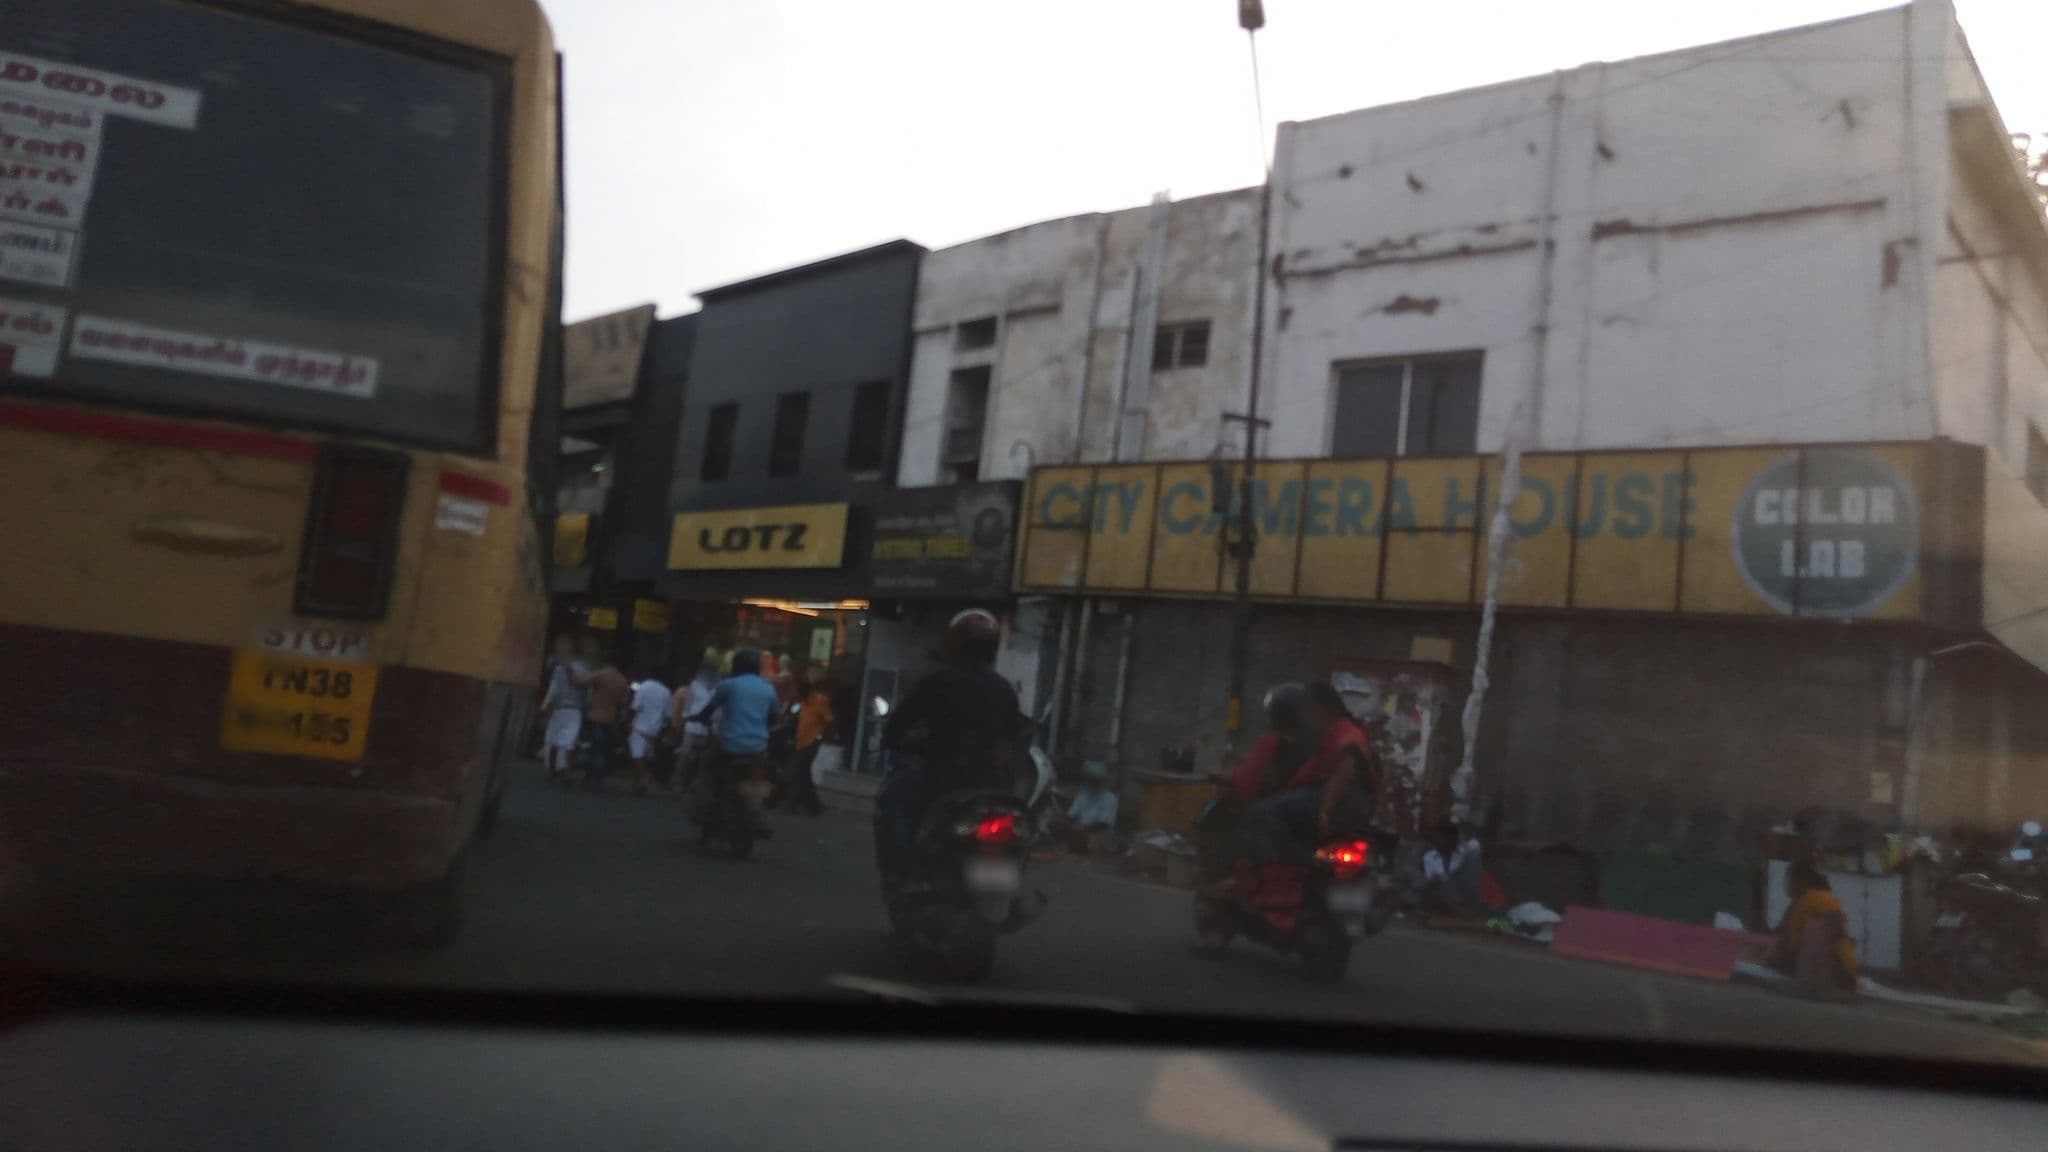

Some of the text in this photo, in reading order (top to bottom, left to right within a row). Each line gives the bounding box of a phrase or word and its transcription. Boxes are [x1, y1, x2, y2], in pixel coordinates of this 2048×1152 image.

[1039, 472, 1698, 540] CITY CAMERA HOUSE
[1753, 486, 1896, 525] COLOR
[698, 523, 808, 553] LOTZ
[1780, 538, 1865, 579] LAB
[263, 627, 362, 656] STOP
